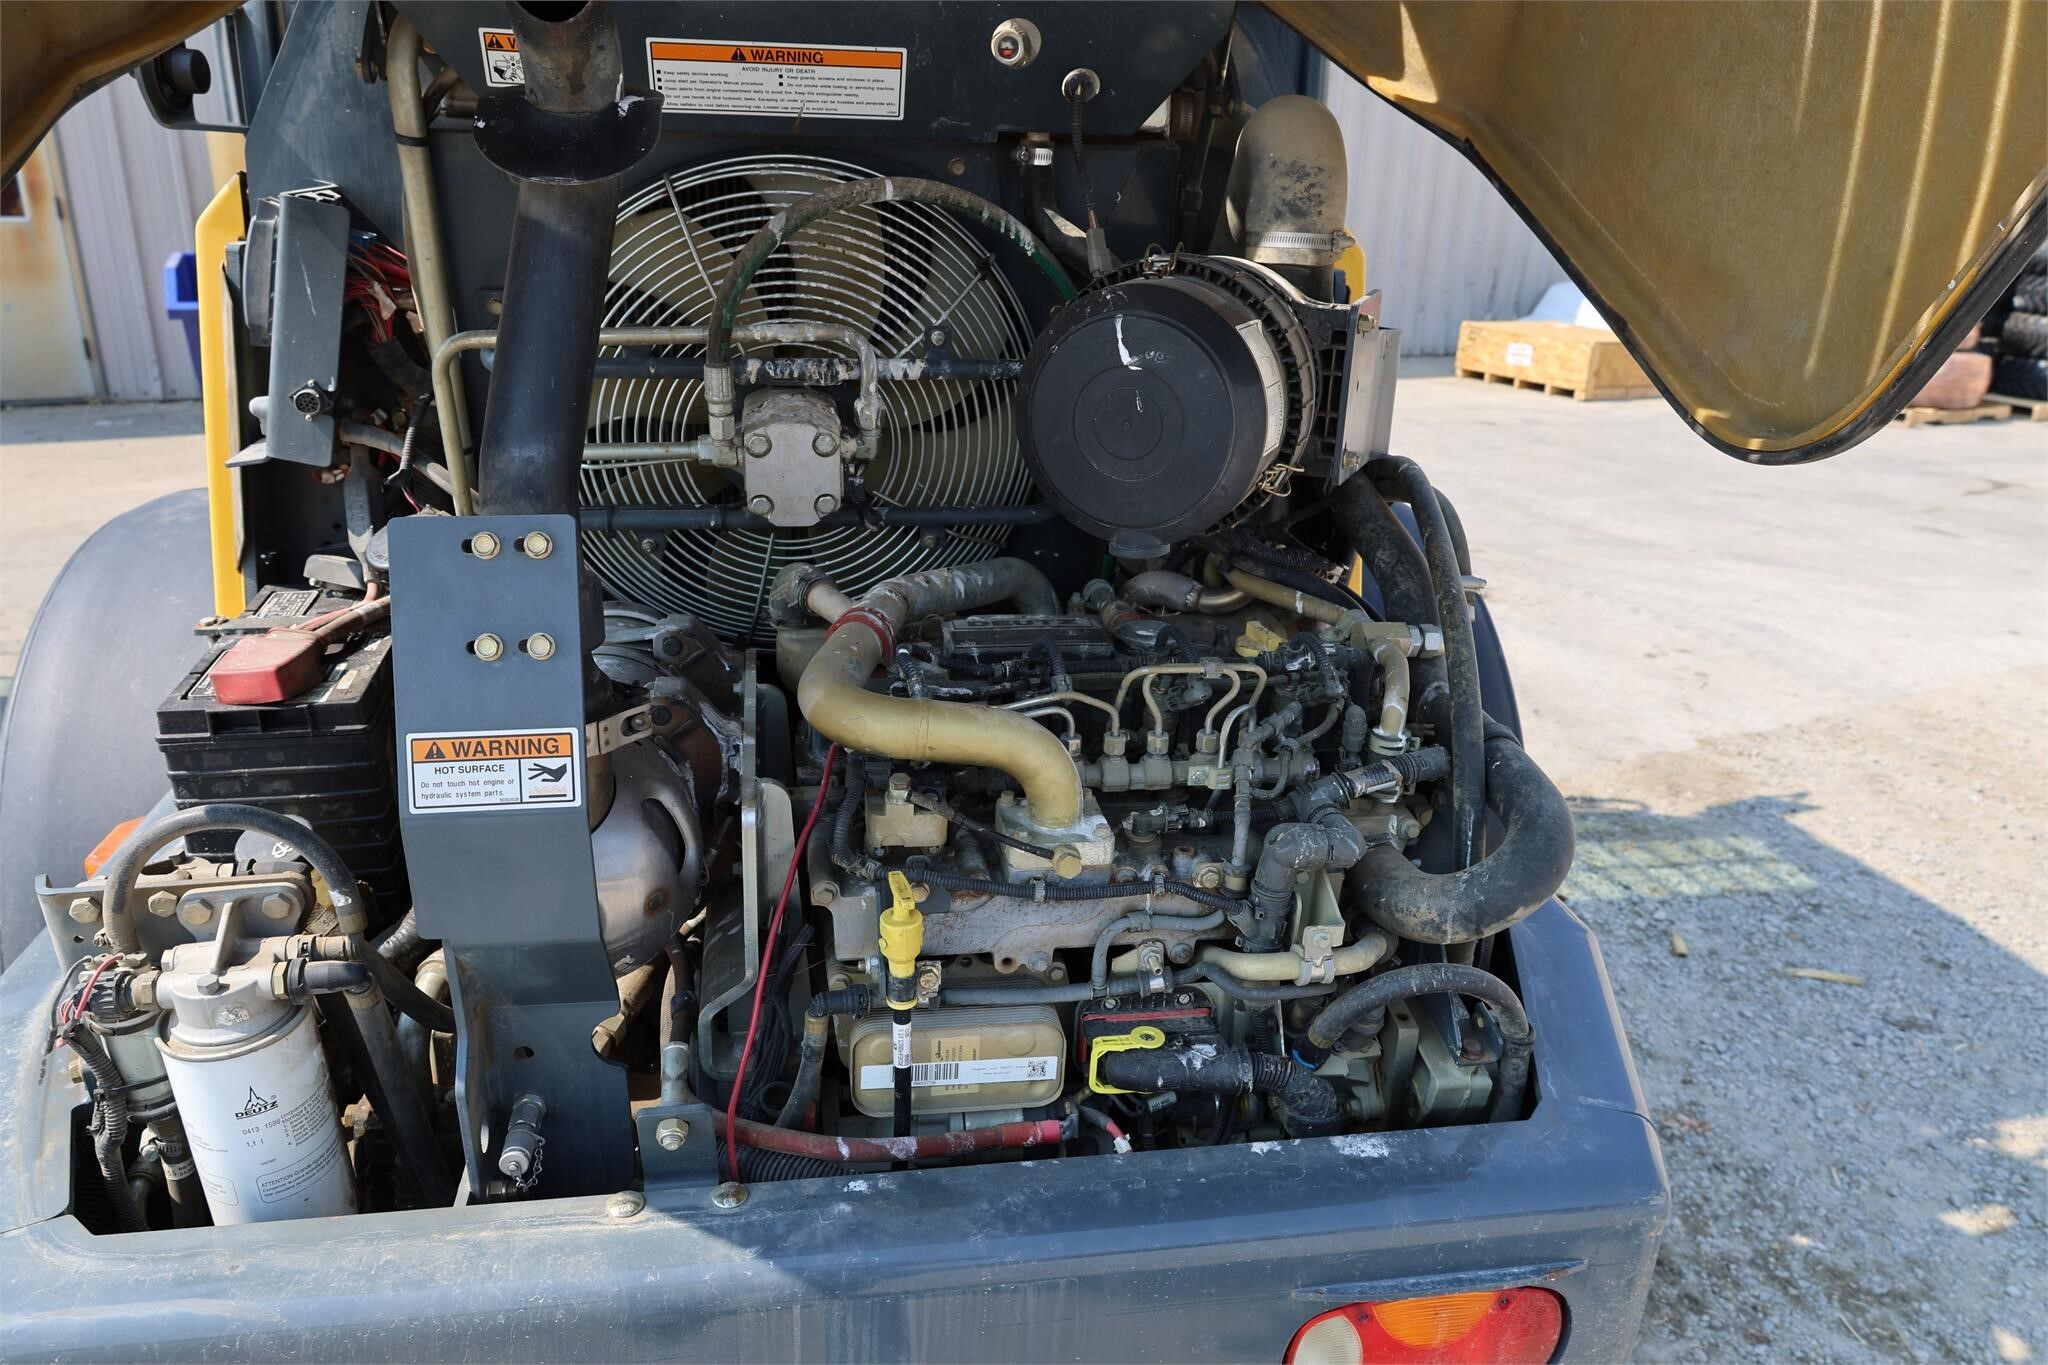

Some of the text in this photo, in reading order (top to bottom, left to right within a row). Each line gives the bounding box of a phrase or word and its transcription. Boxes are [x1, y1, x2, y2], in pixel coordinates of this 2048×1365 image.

[750, 49, 824, 64] WARNING
[451, 737, 560, 758] WARNING
[434, 764, 505, 775] HOT SURFACE
[420, 781, 430, 789] Do
[447, 780, 466, 788] touch
[468, 779, 480, 787] hot
[483, 778, 505, 787] engine
[421, 789, 505, 801] hydraulic system parts.
[235, 1100, 278, 1118] DEUTZ
[242, 1126, 260, 1136] 0413
[261, 1173, 294, 1188] ATTENTION
